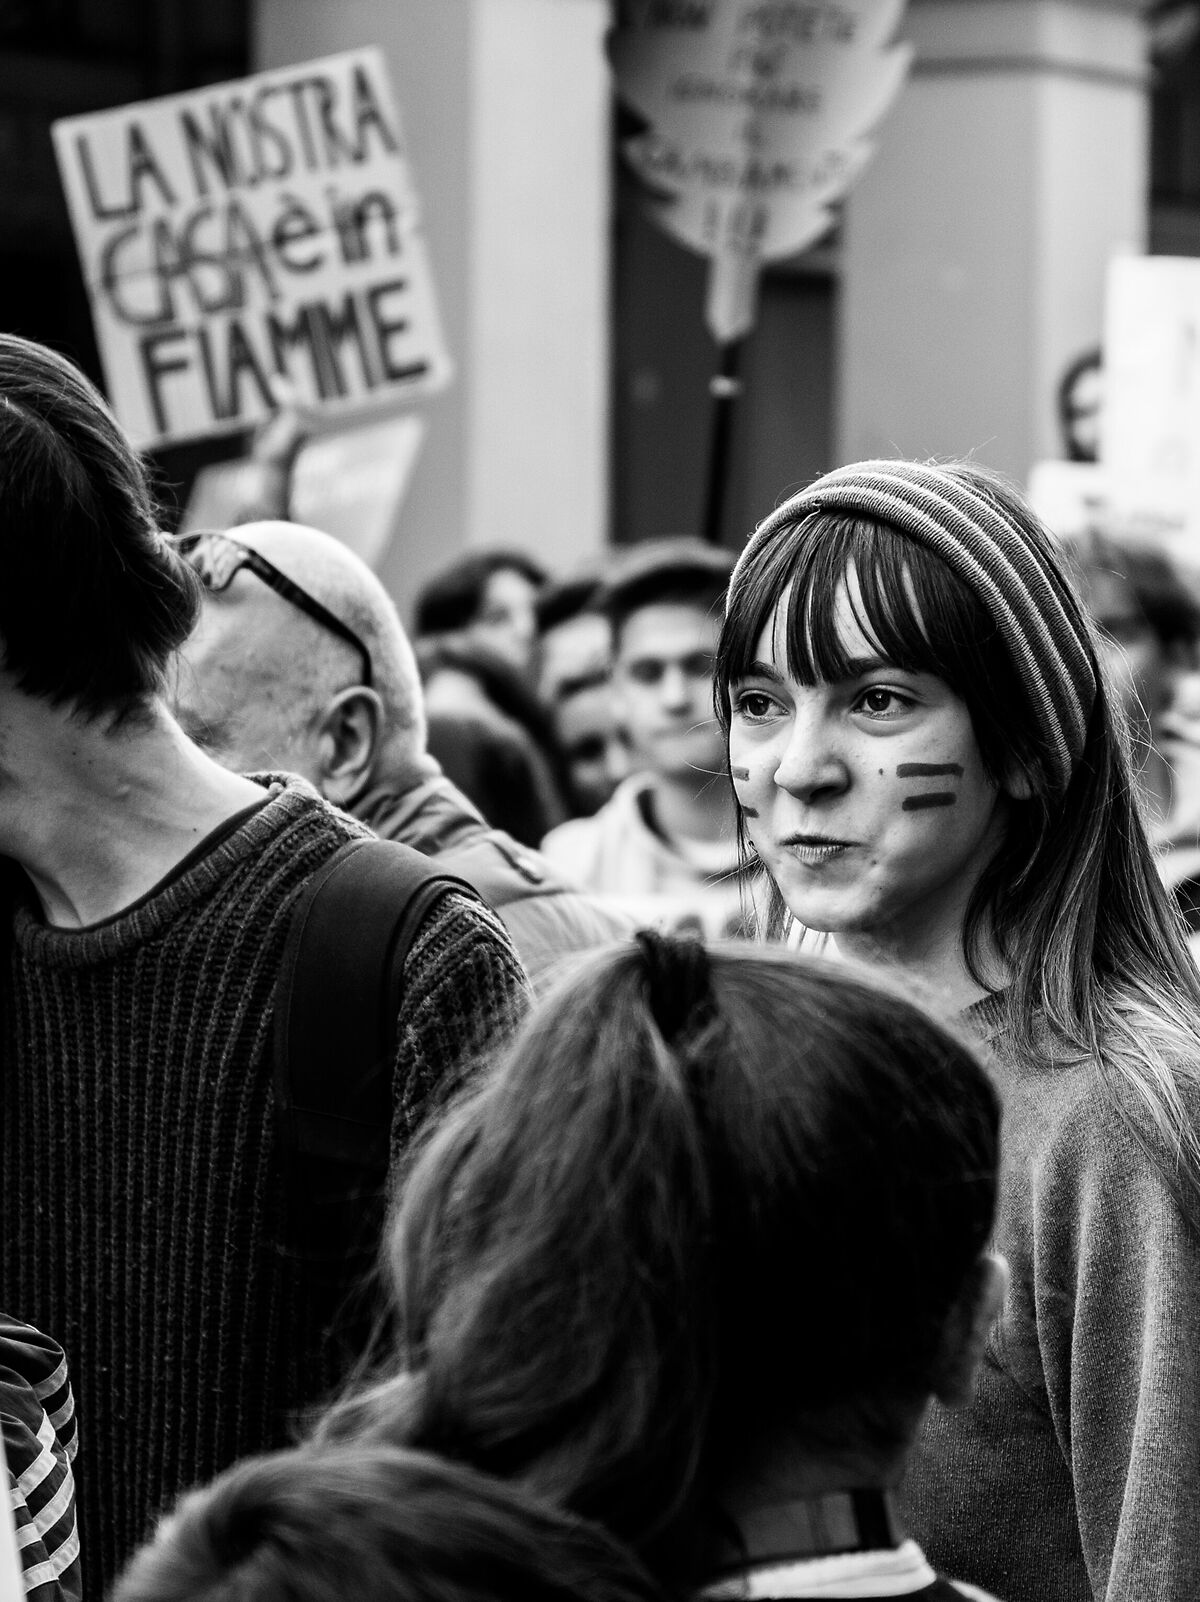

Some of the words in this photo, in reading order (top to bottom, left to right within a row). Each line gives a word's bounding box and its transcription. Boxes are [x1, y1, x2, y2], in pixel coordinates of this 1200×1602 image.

[74, 119, 179, 221] LA
[179, 63, 399, 196] NOSTRA
[100, 202, 283, 328] CASA
[271, 191, 326, 273] è
[326, 186, 399, 264] in
[140, 277, 429, 434] FIAMME
